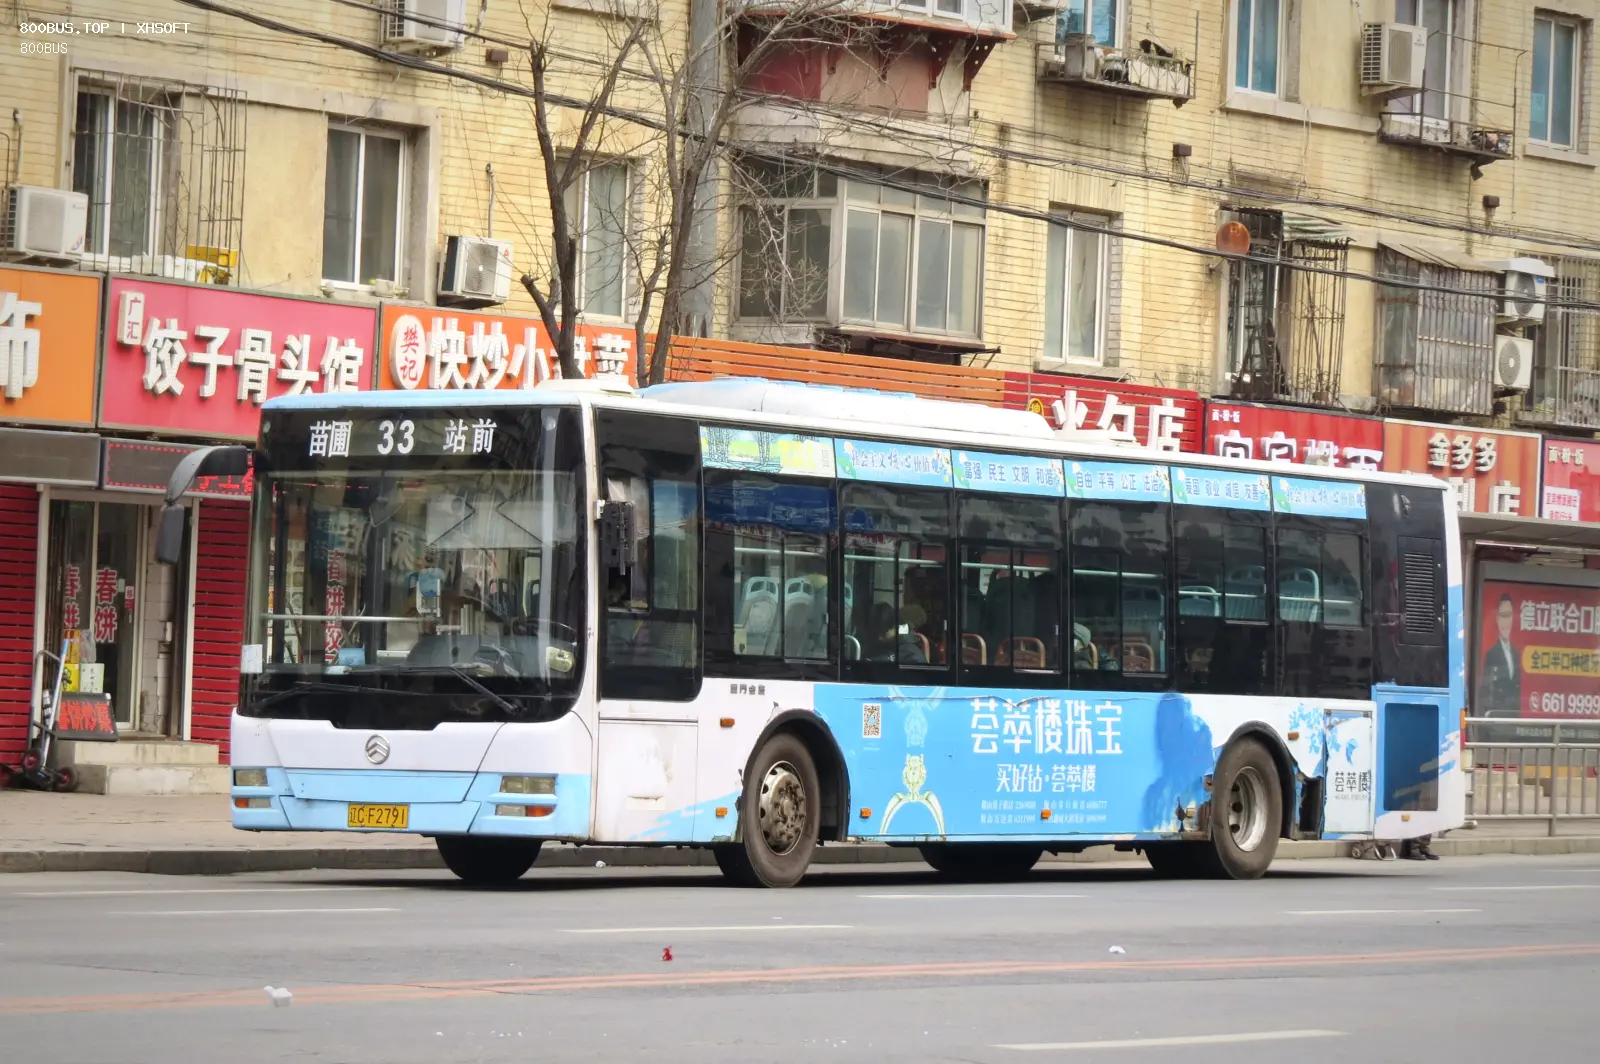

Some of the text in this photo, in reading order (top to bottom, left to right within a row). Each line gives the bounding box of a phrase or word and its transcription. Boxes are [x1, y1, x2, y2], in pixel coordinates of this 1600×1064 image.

[126, 296, 142, 340] 广汇
[142, 317, 364, 404] 饺子骨头馆
[399, 324, 420, 382] 樊记
[309, 418, 498, 457] 苗圃 33 站前
[1428, 432, 1497, 472] 金多多
[988, 463, 1006, 482] 民主
[1012, 466, 1030, 485] 文明
[1076, 472, 1093, 489] 自由
[1098, 472, 1115, 490] 平等
[1121, 474, 1137, 491] 公正
[95, 568, 118, 643] 春饼
[970, 698, 1123, 755] 荟萃楼珠宝
[1335, 771, 1369, 792] 荟萃楼
